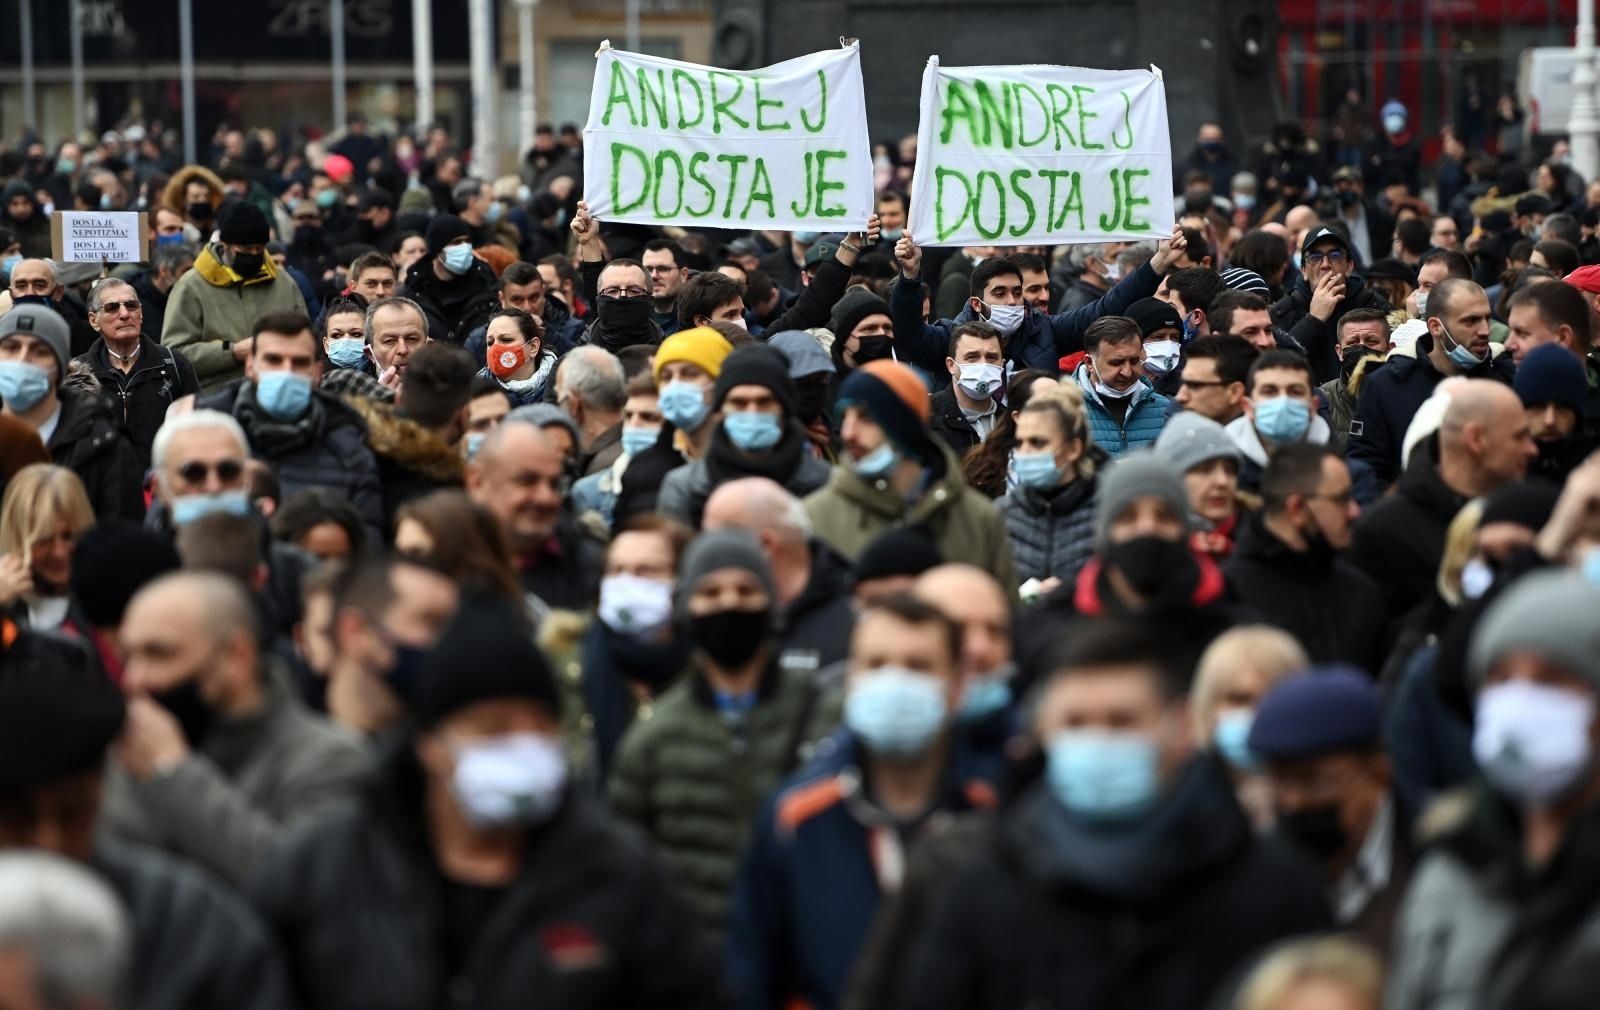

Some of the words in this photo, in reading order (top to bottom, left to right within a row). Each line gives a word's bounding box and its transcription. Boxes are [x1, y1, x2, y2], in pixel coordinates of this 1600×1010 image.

[602, 61, 826, 134] ANDREJ
[940, 79, 1131, 151] ANDREJ
[611, 143, 775, 219] DOSTA
[790, 150, 847, 218] JE
[935, 165, 1084, 242] DOSTA
[1099, 168, 1151, 232] JE
[73, 241, 105, 249] DOSTA
[106, 241, 117, 249] JE
[818, 245, 829, 257] P
